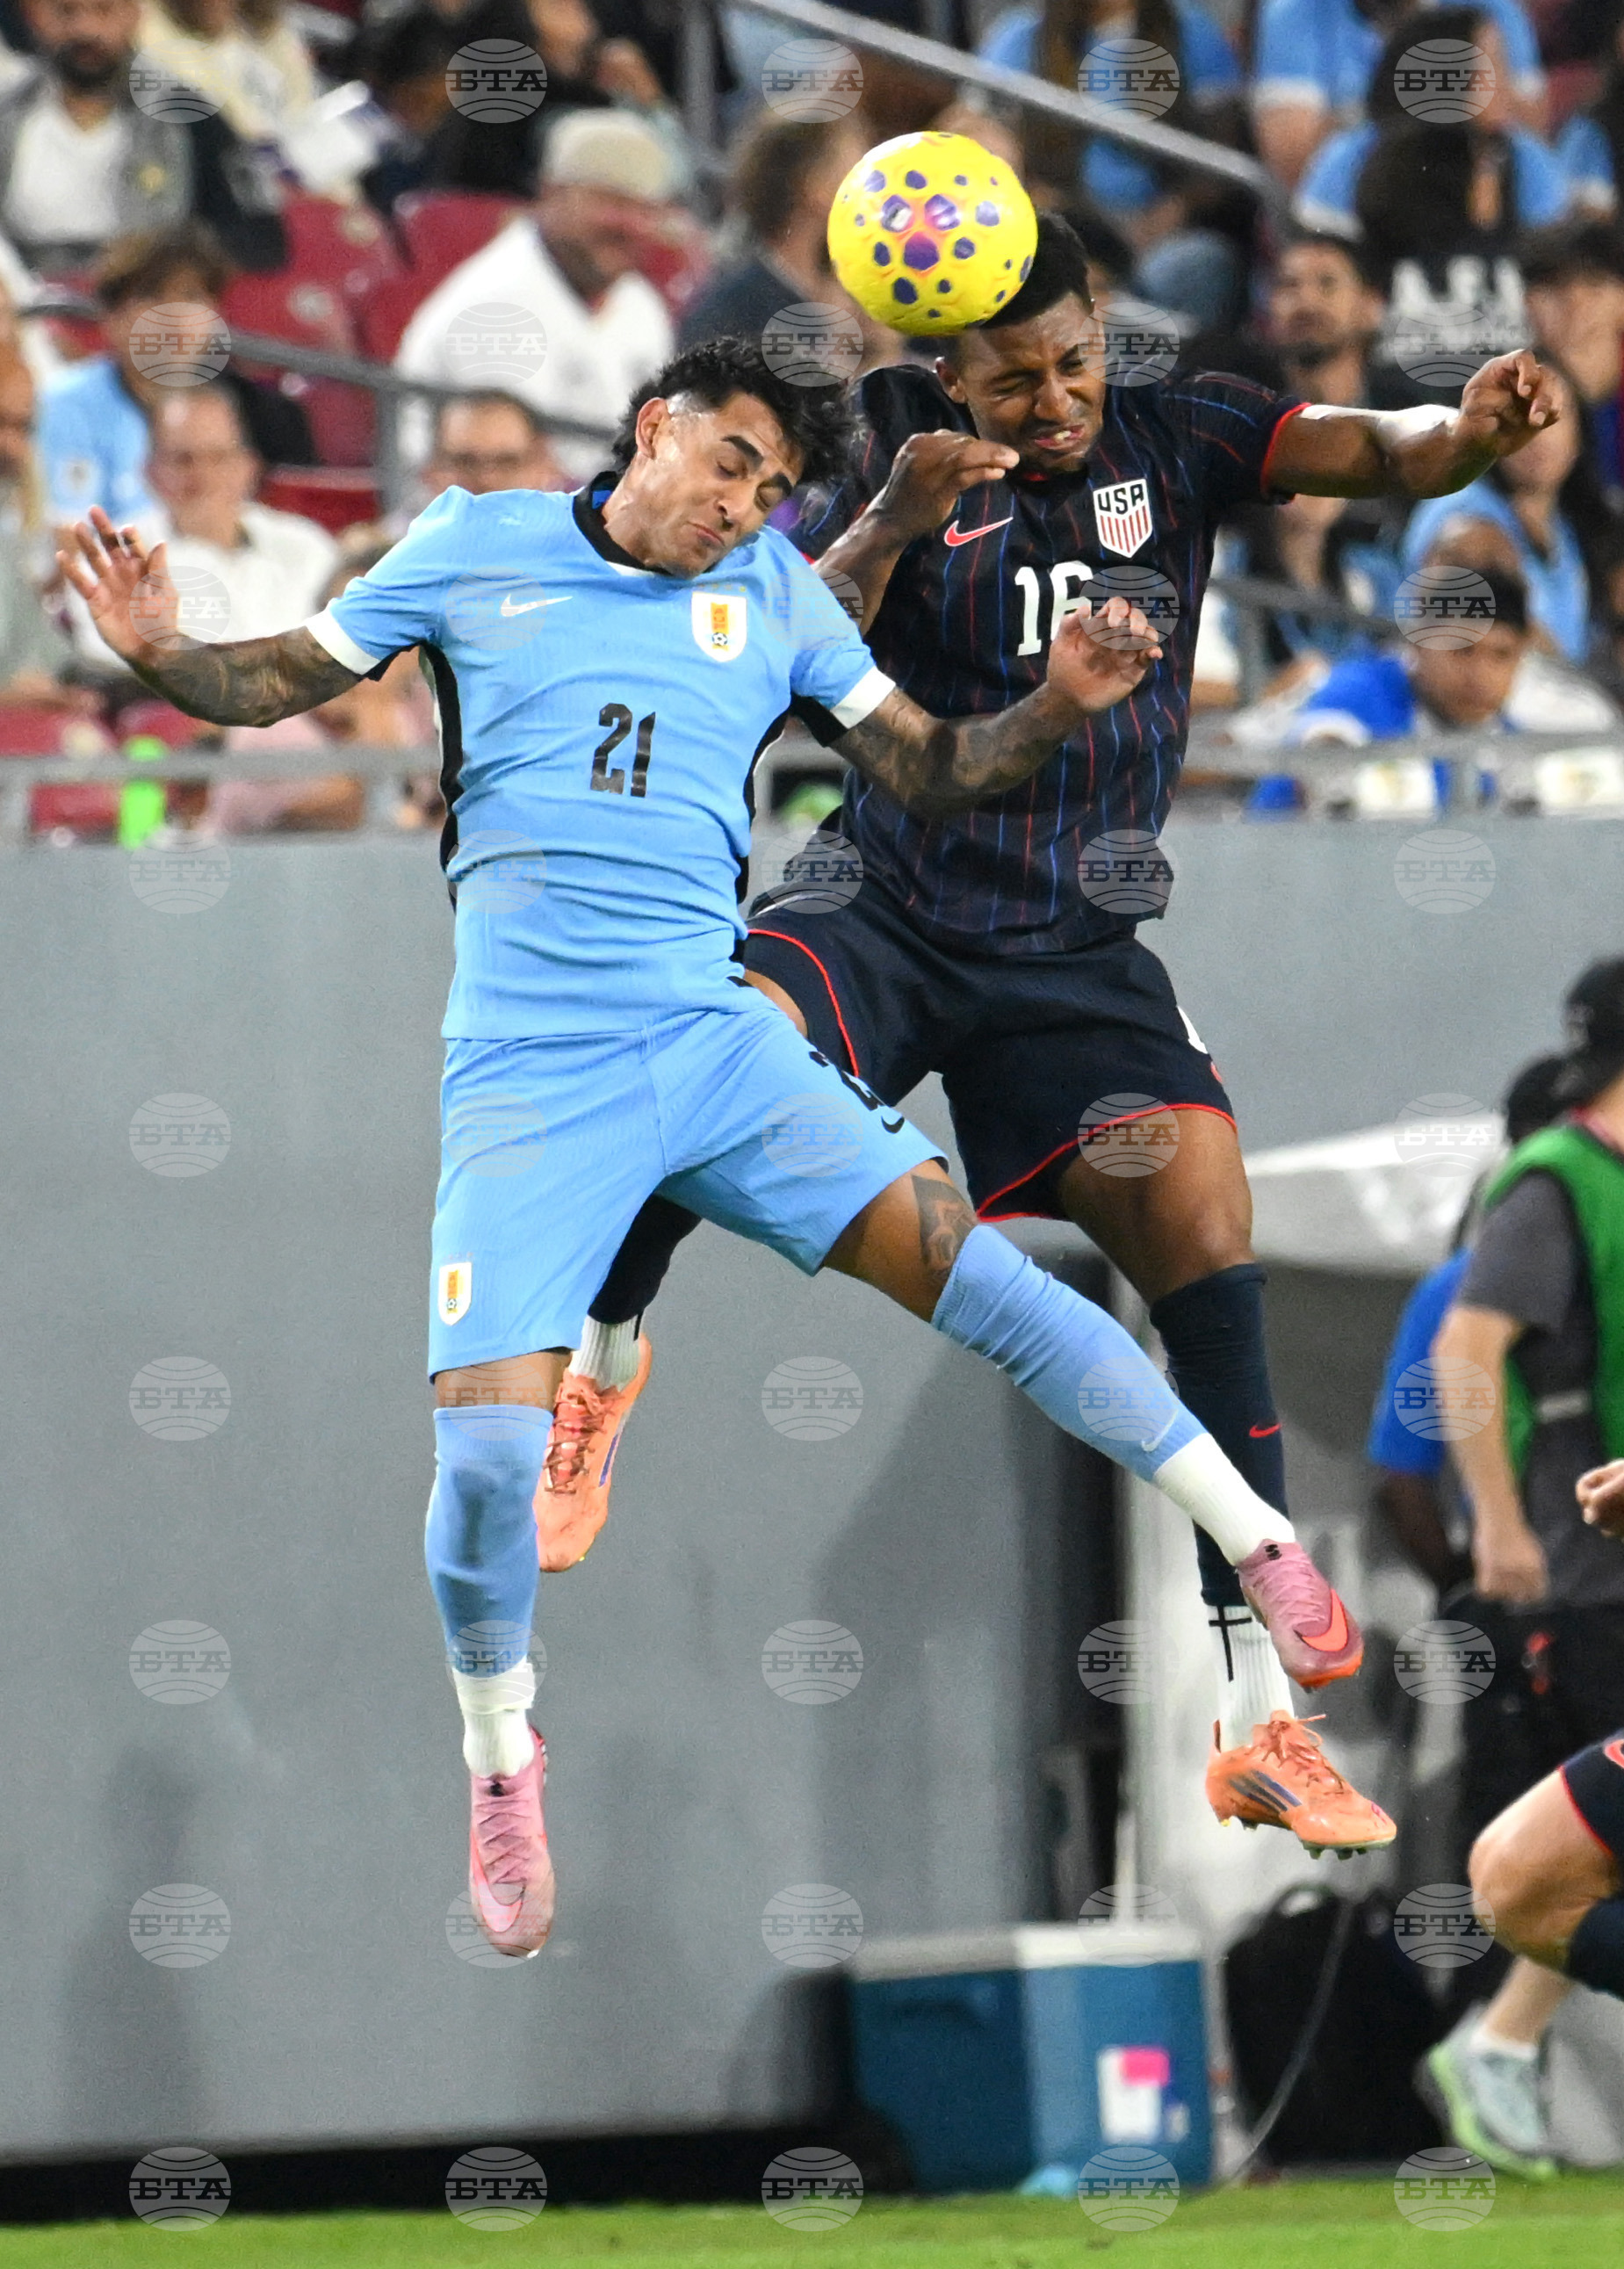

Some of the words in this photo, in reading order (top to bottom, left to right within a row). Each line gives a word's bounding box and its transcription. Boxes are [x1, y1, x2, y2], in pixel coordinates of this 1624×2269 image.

[1098, 484, 1144, 515] USA
[1014, 560, 1093, 656] 16
[590, 703, 655, 798] 21
